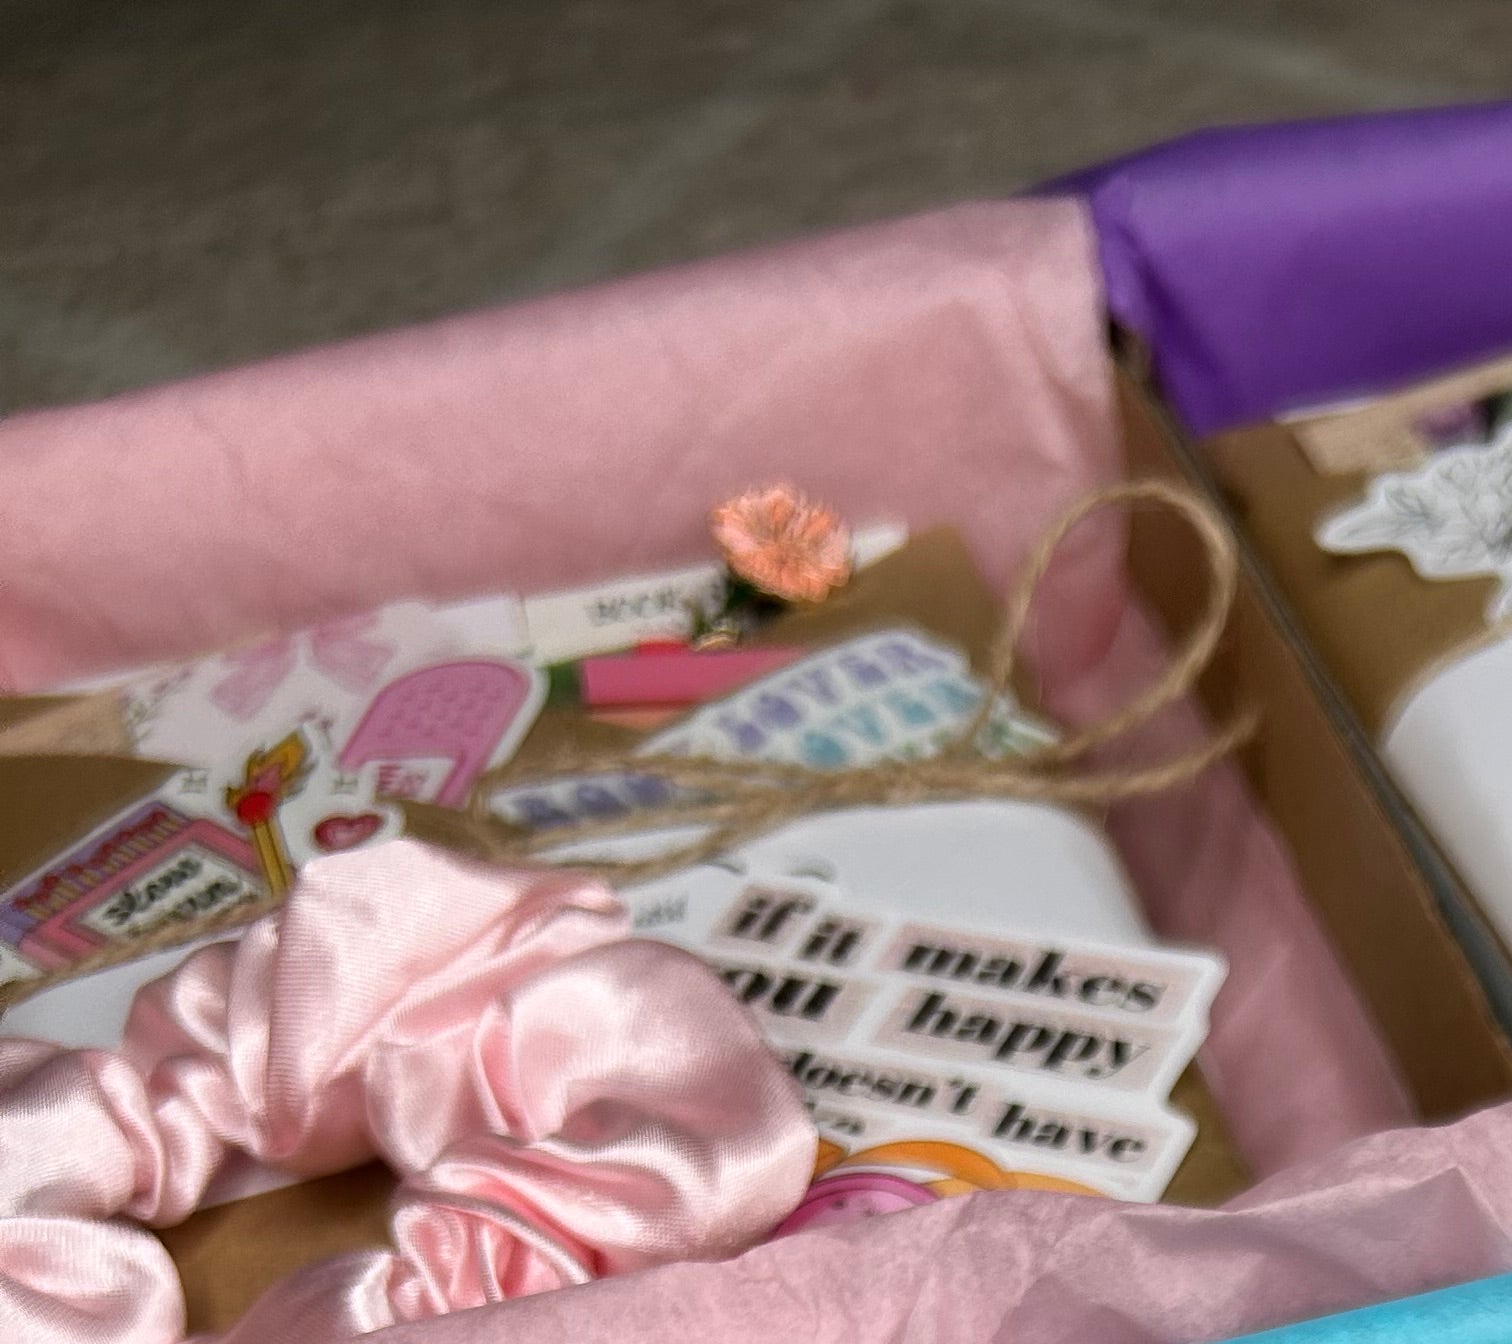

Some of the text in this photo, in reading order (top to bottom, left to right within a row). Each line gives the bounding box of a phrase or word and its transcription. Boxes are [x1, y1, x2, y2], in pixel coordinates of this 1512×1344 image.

[731, 893, 816, 940] if
[801, 919, 863, 966] it
[902, 947, 1170, 1014] makes
[720, 967, 1151, 1081] ou happy
[990, 1101, 1149, 1164] have
